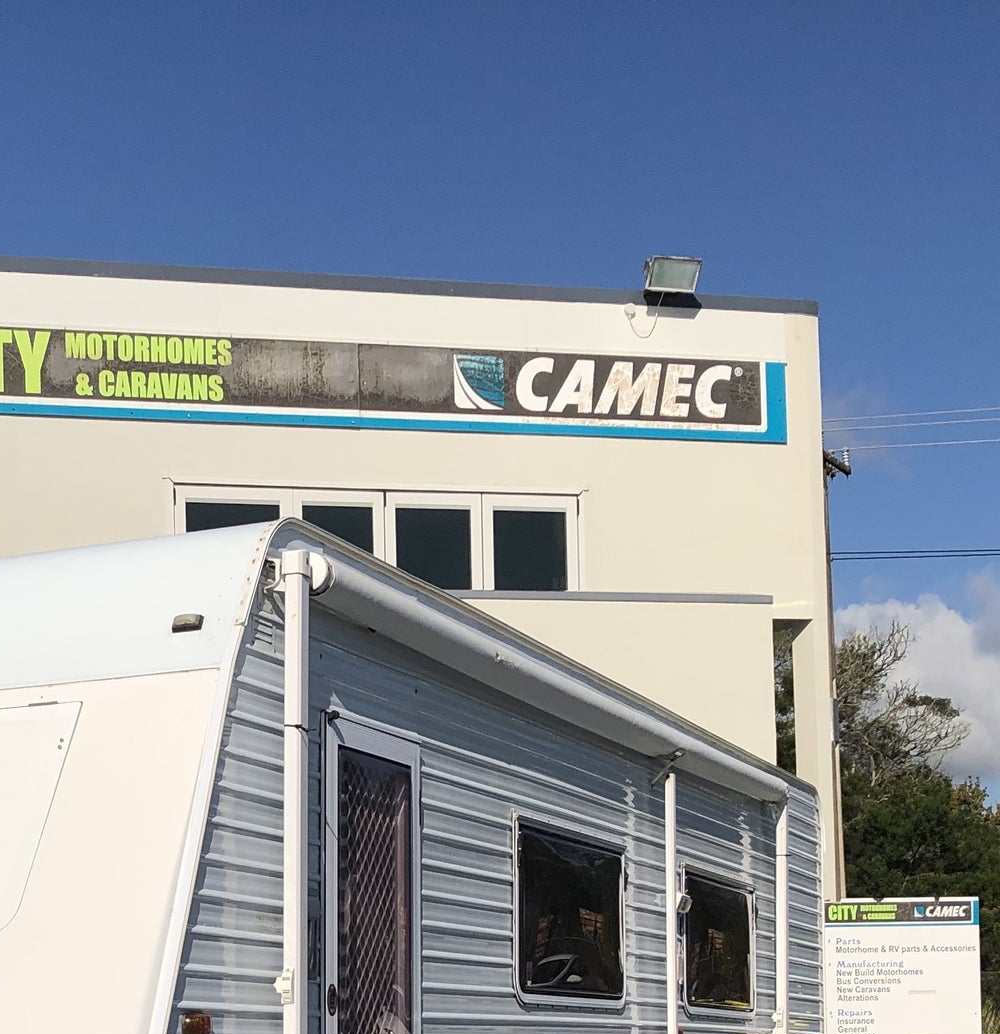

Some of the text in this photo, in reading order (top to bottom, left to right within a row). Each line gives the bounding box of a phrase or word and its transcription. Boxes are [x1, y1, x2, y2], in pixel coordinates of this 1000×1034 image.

[65, 332, 232, 366] MOTORHOMES
[75, 370, 224, 402] & CARAVANS
[516, 357, 731, 418] CAMEC
[828, 905, 858, 921] CITY
[925, 905, 969, 918] CAMEC
[836, 937, 861, 946] Parts
[836, 943, 977, 954] Motorhome & RV parts & Accessories
[837, 960, 904, 969] Manufacturing
[836, 968, 924, 977] New Build Motorhomes
[837, 977, 902, 986] Bus Conversions
[837, 985, 891, 994] New Caravans
[837, 994, 879, 1002] Alterations
[838, 1008, 873, 1017] Repairs
[837, 1017, 875, 1025] Insurance
[838, 1025, 868, 1034] General
